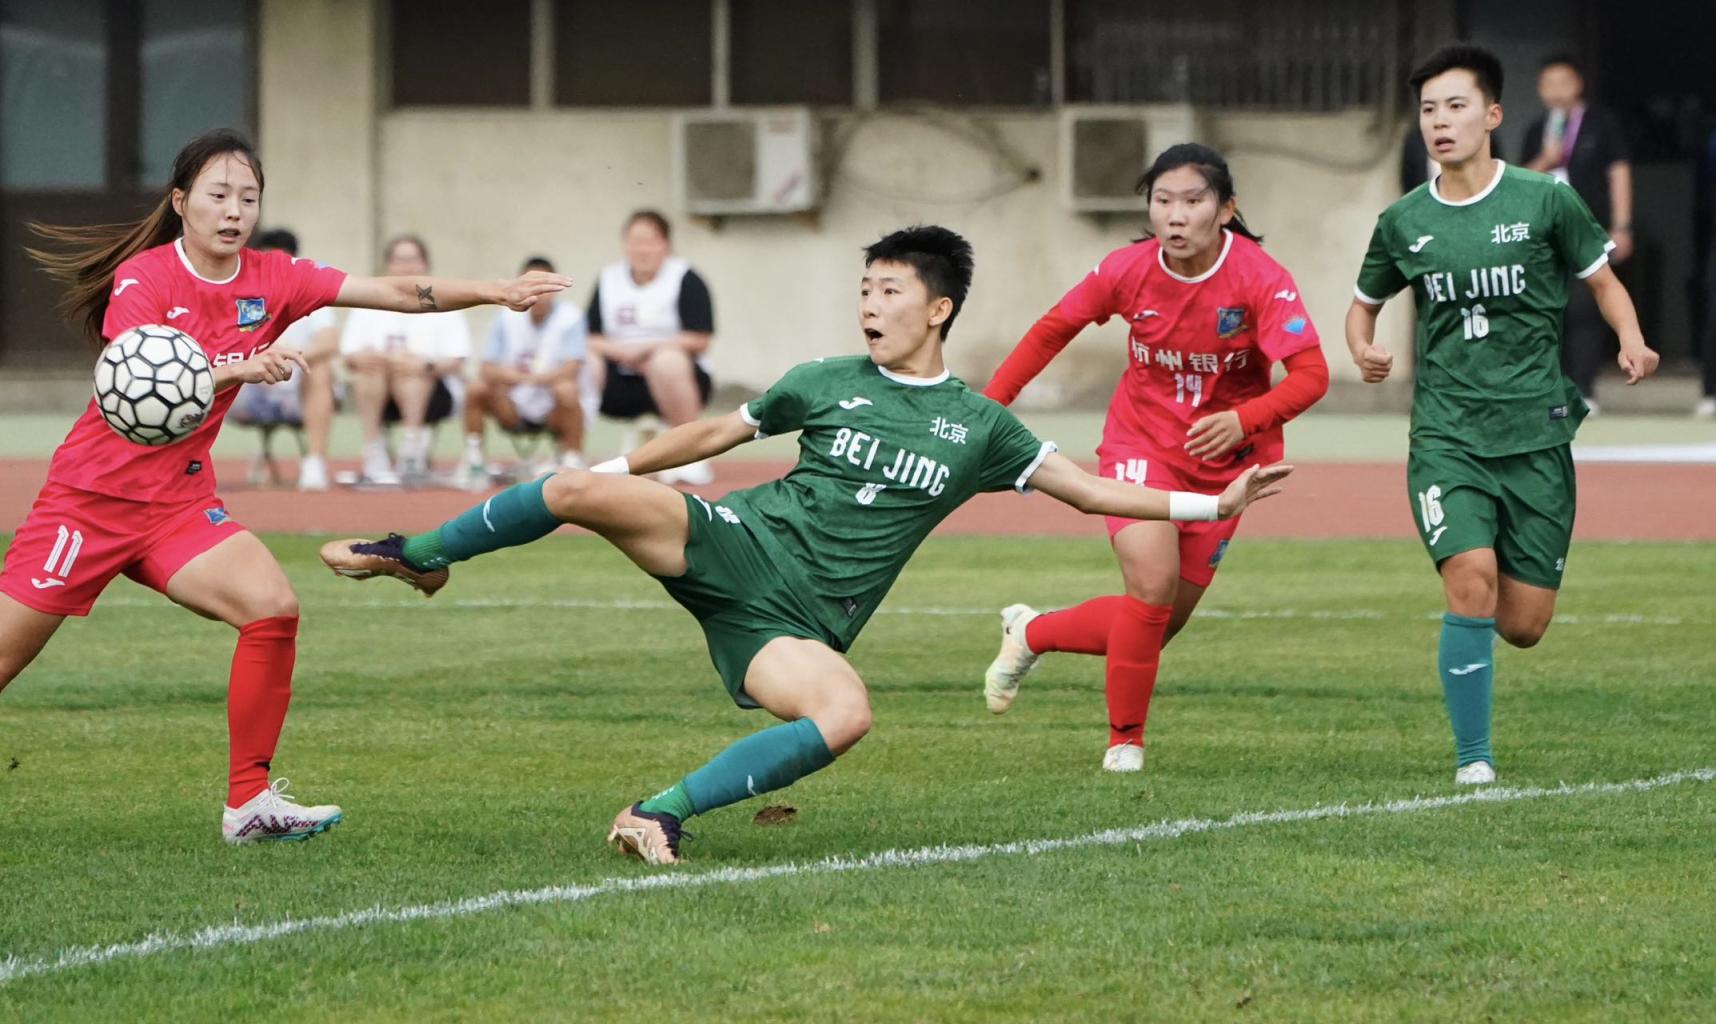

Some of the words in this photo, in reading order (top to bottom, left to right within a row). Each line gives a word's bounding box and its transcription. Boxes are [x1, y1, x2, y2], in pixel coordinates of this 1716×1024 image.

[1490, 221, 1530, 245] 北京
[1465, 264, 1526, 299] JING
[1460, 303, 1489, 340] 16
[1132, 336, 1249, 374] 杭州银行
[1174, 373, 1202, 408] 14
[929, 416, 969, 445] 北京
[829, 427, 880, 471] BEI
[882, 448, 950, 497] JING
[1115, 458, 1148, 486] 14
[1418, 484, 1445, 533] 16
[43, 524, 84, 578] 11
